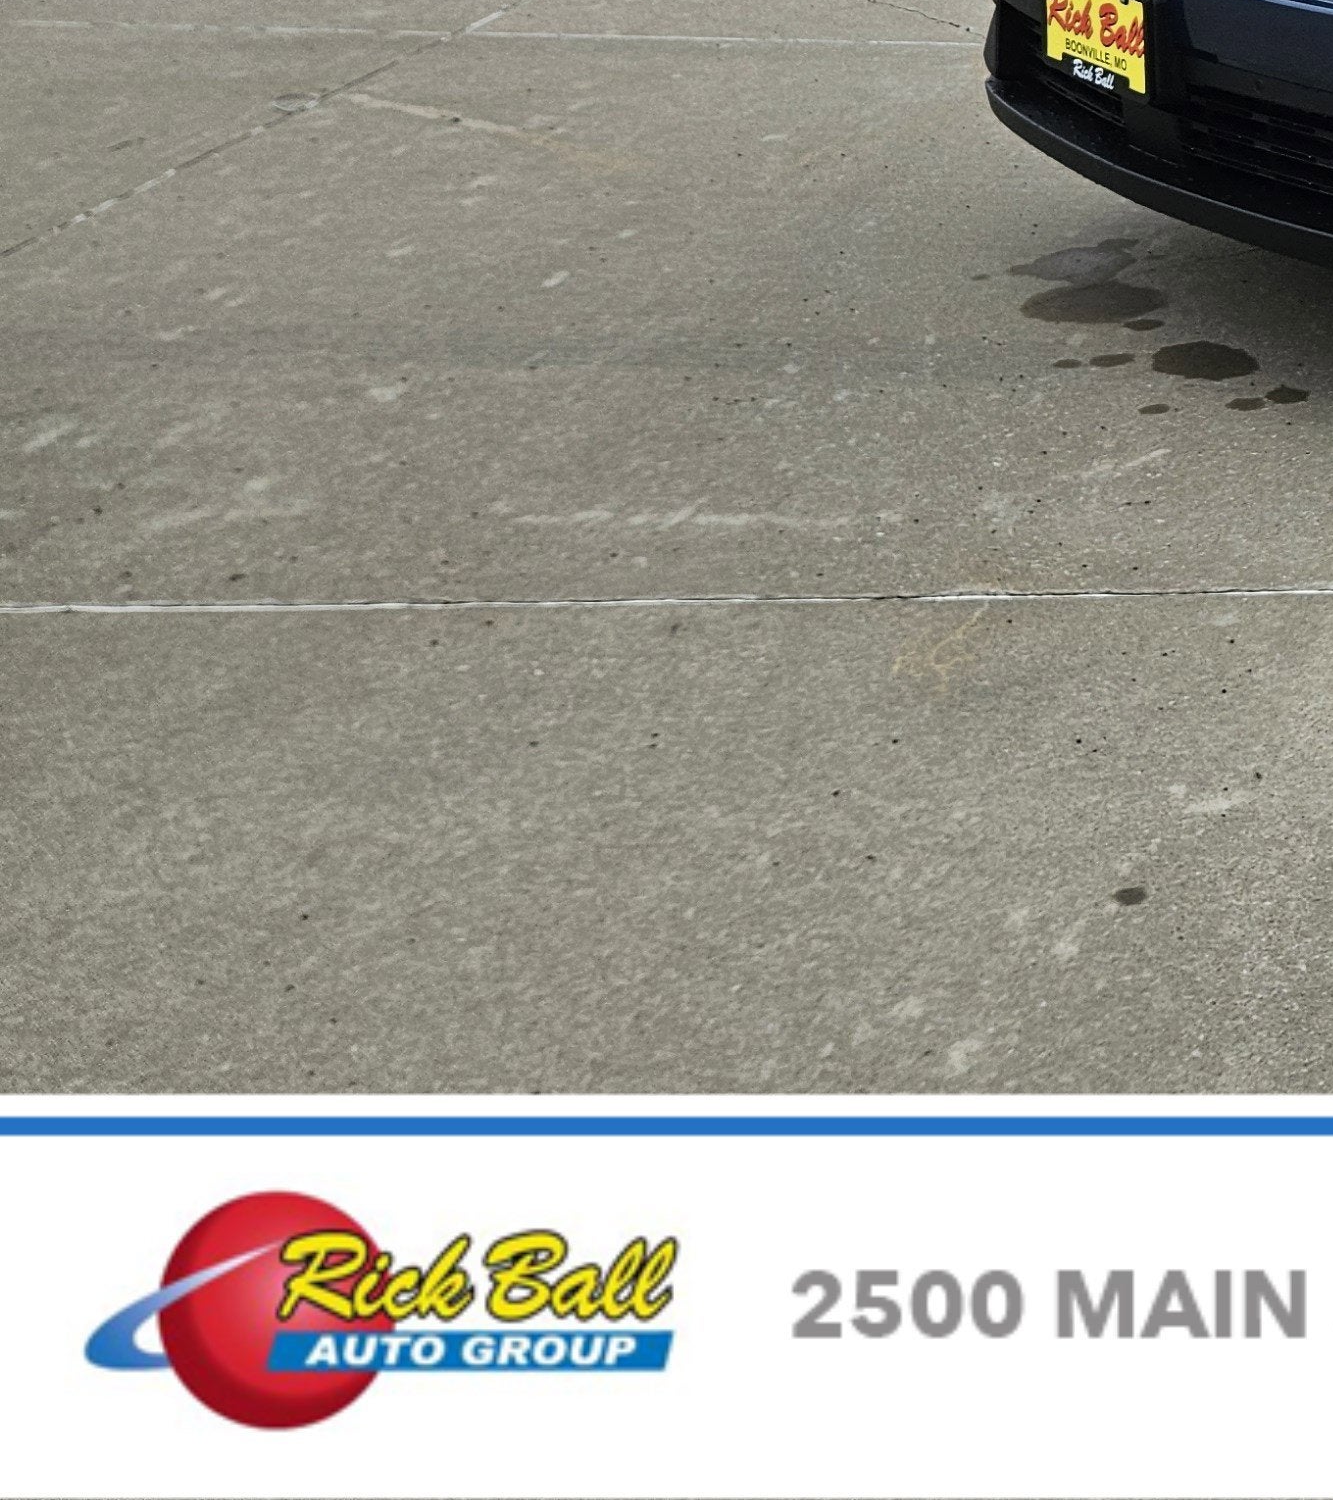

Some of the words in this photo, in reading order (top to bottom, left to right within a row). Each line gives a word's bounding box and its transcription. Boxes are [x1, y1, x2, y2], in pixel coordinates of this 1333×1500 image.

[1098, 2, 1145, 58] Ball
[1072, 58, 1094, 82] Rick
[1094, 67, 1115, 90] Ball
[1114, 55, 1128, 71] MO
